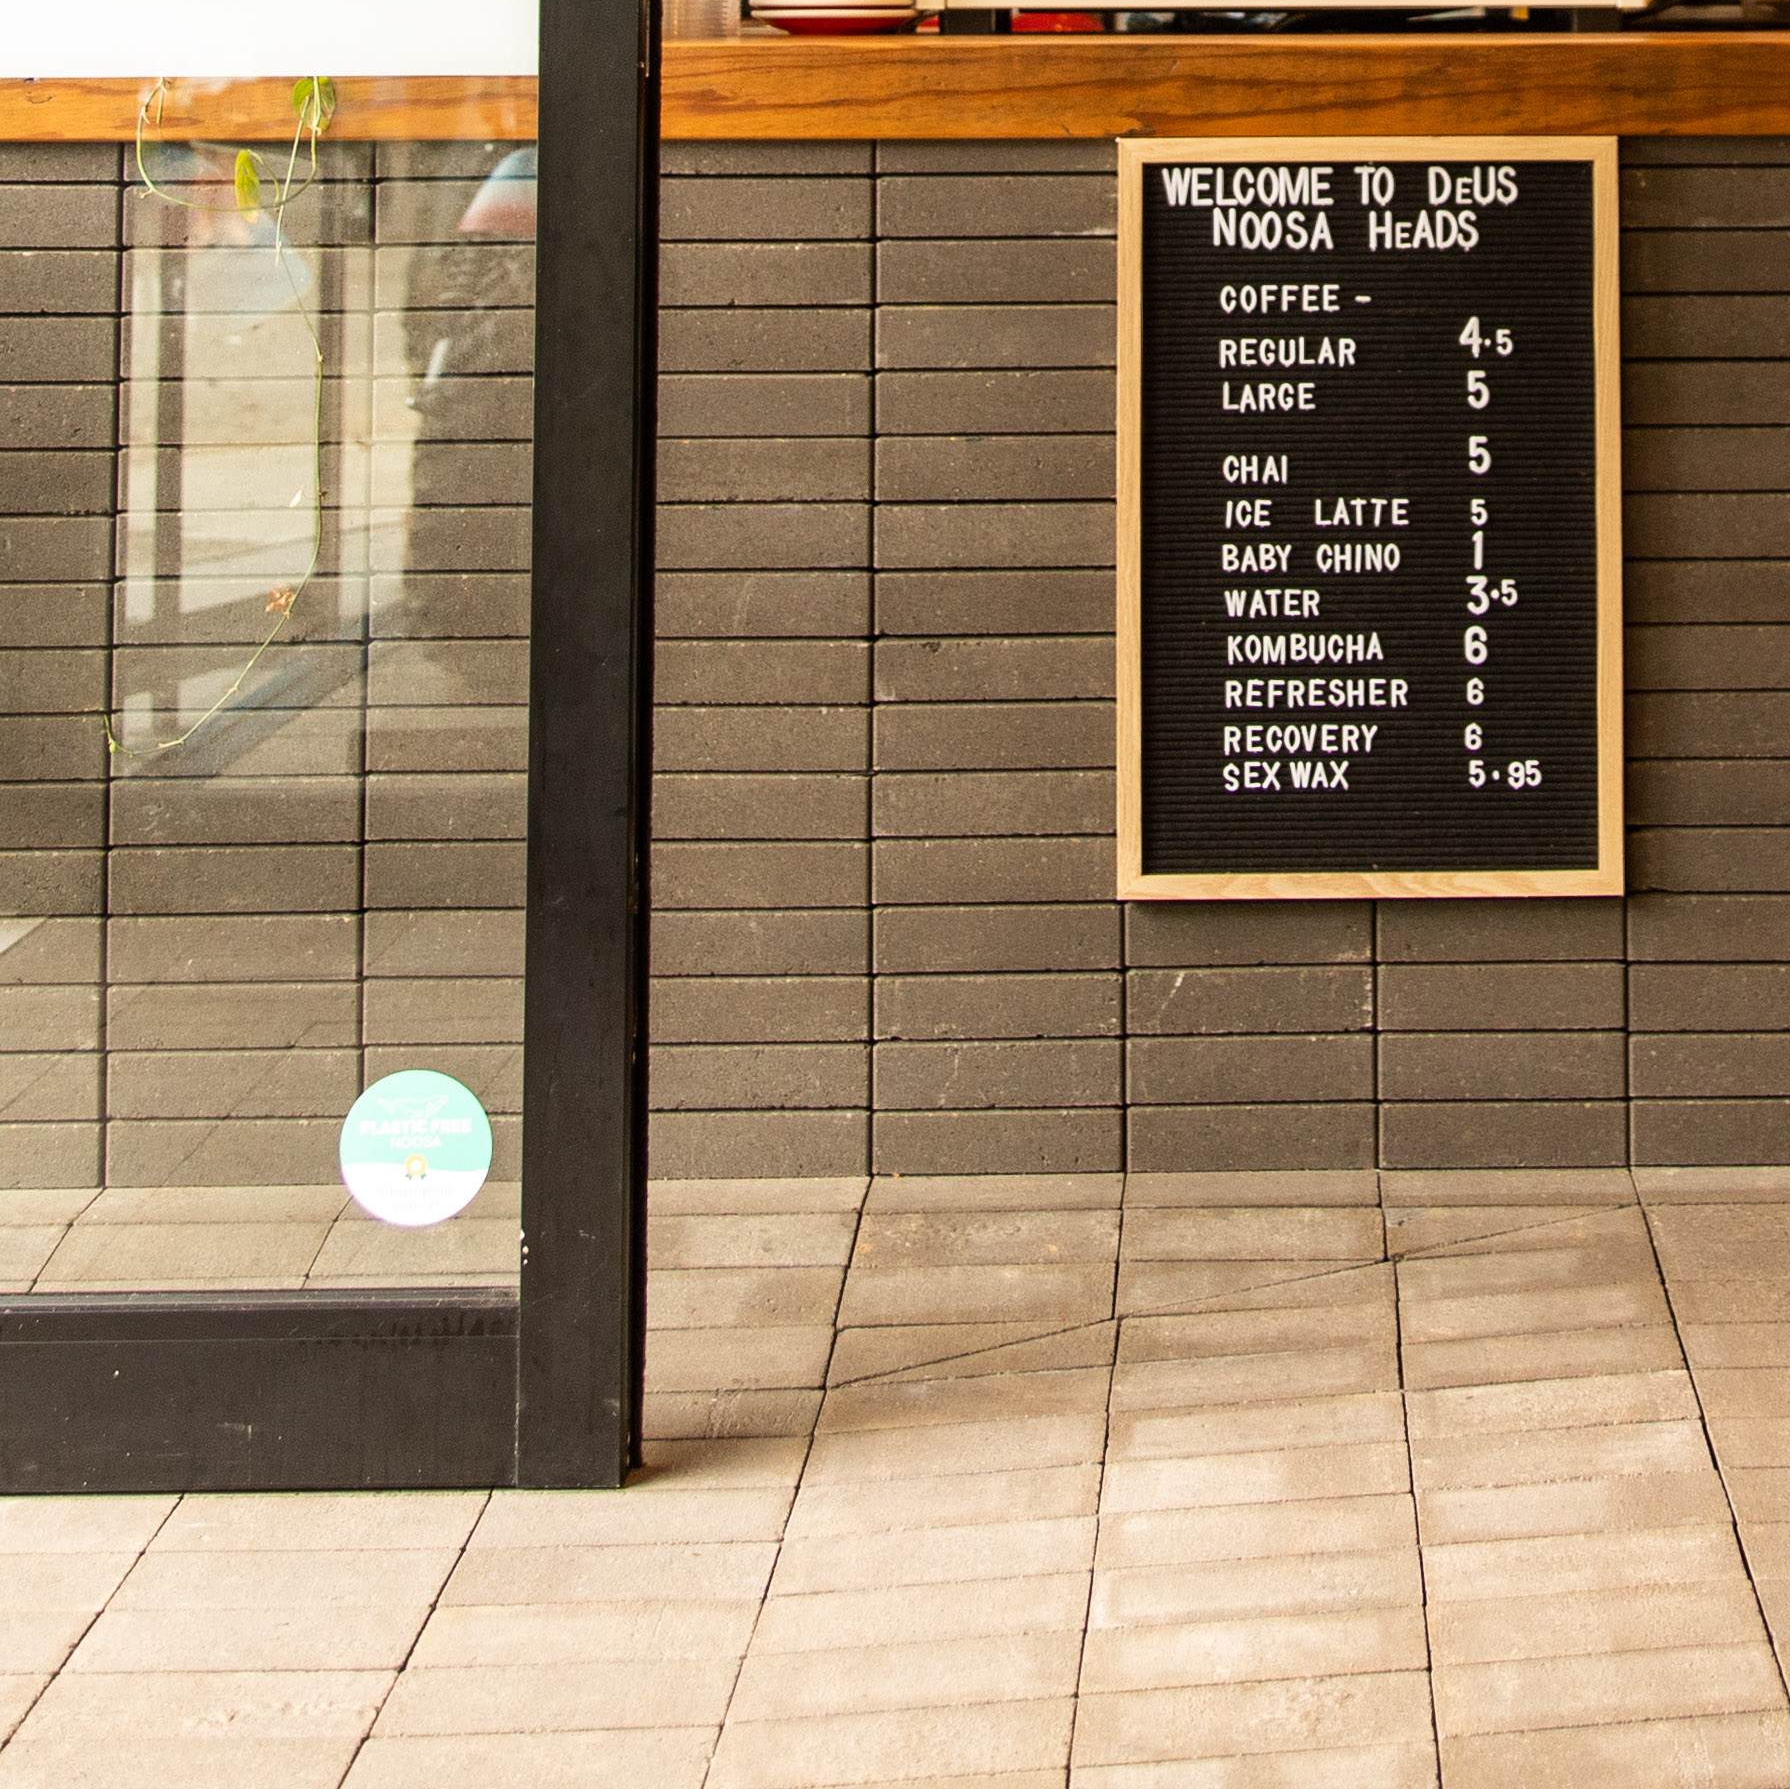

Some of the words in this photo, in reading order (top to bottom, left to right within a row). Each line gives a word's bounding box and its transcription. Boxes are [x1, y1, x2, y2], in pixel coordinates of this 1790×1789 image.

[1161, 166, 1335, 207] WELCOME
[1353, 166, 1395, 206] TO
[1212, 208, 1334, 251] NOOSA
[1219, 284, 1341, 314] COFFEE
[1219, 337, 1357, 369] REGULAR
[1222, 382, 1316, 413] LARGE
[1466, 370, 1490, 410] 5
[1222, 455, 1289, 485] CHAI
[1468, 435, 1492, 474] 5
[1225, 499, 1272, 528] ICE
[1313, 497, 1410, 527] LATTE
[1470, 498, 1489, 526] 5
[1221, 542, 1293, 574] BABY
[1316, 542, 1402, 574] CHINO
[1471, 530, 1485, 571] 1
[1224, 589, 1321, 619] WATER
[1226, 632, 1384, 666] KOMBUCHA
[1463, 626, 1489, 665] 6
[1224, 678, 1409, 709] REFRESHER
[1466, 677, 1485, 706] 6
[1223, 724, 1378, 756] RECOVERY
[1464, 722, 1483, 751] 6
[1222, 762, 1281, 793] SEX
[1289, 761, 1349, 791] WAX
[359, 1119, 428, 1137] PLASTIC
[429, 1118, 473, 1134] FREE
[389, 1135, 443, 1150] NOOSA
